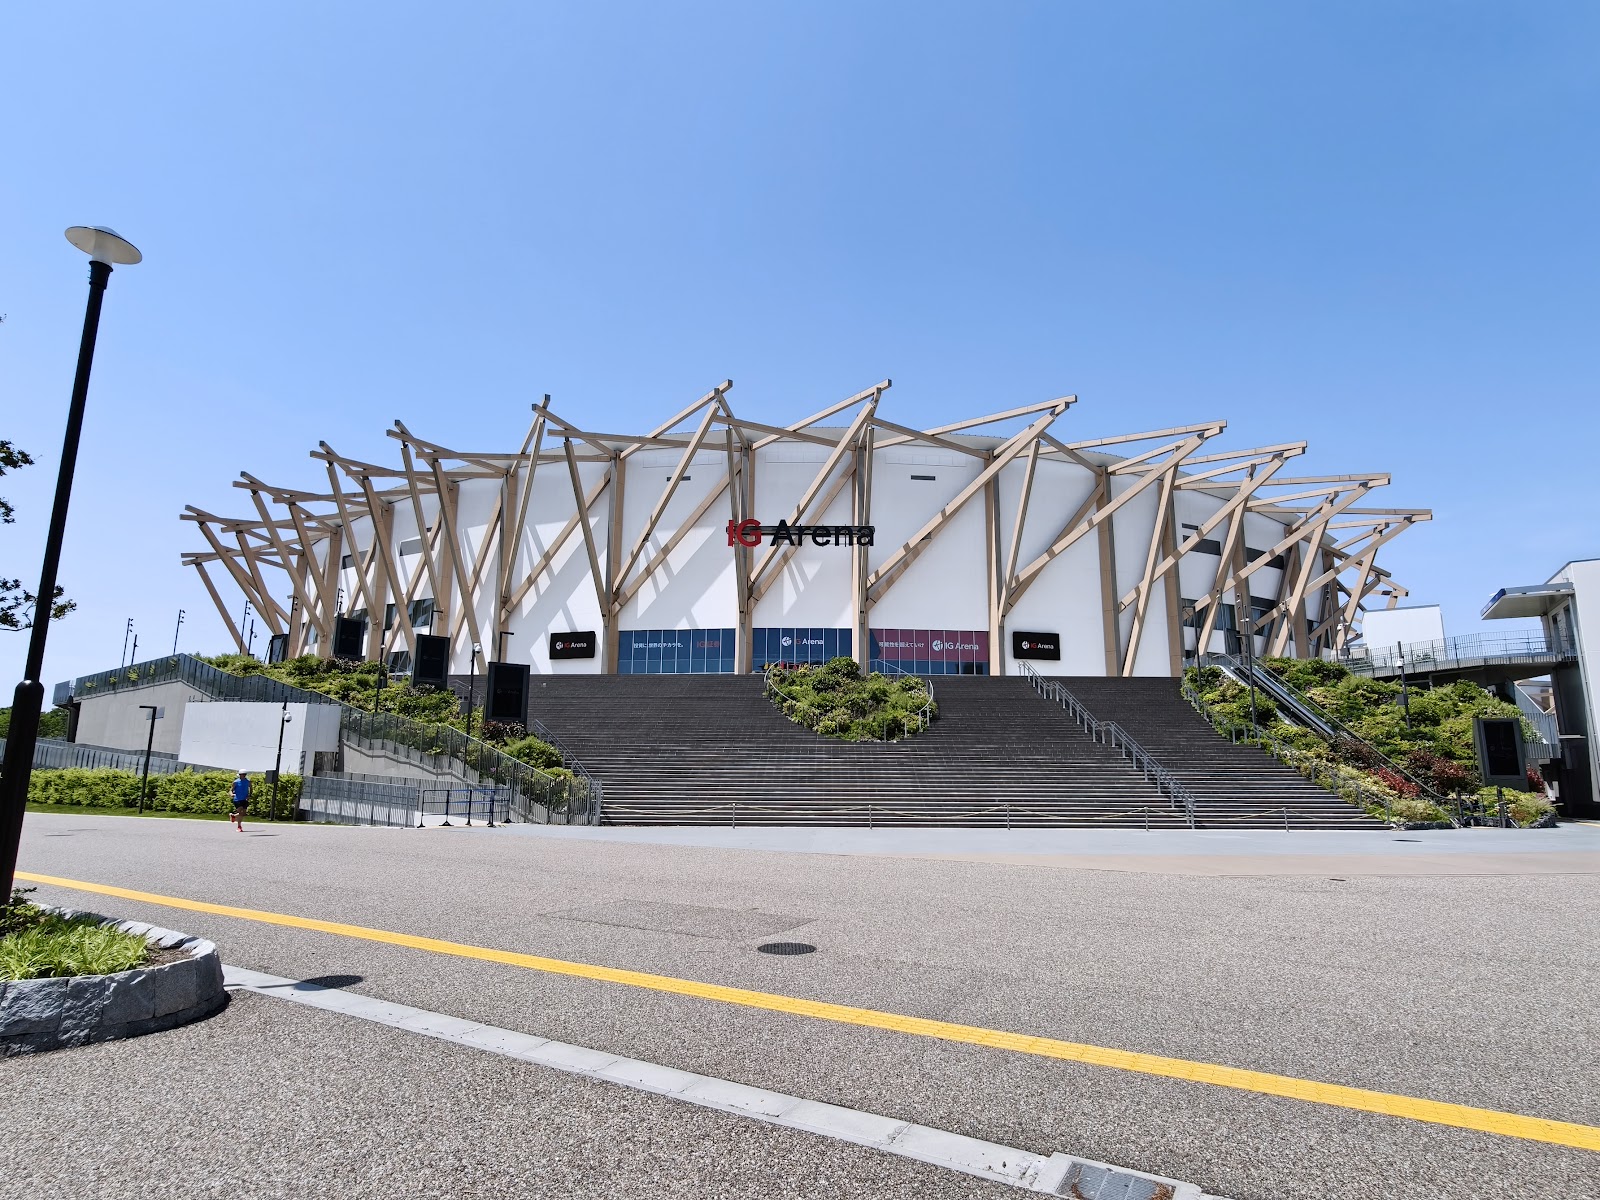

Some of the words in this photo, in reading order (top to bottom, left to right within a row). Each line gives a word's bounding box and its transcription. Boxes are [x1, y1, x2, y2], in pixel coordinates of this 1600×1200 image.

[727, 518, 762, 547] IG
[770, 519, 874, 547] Arena
[945, 642, 954, 650] IG
[955, 642, 979, 650] Arena
